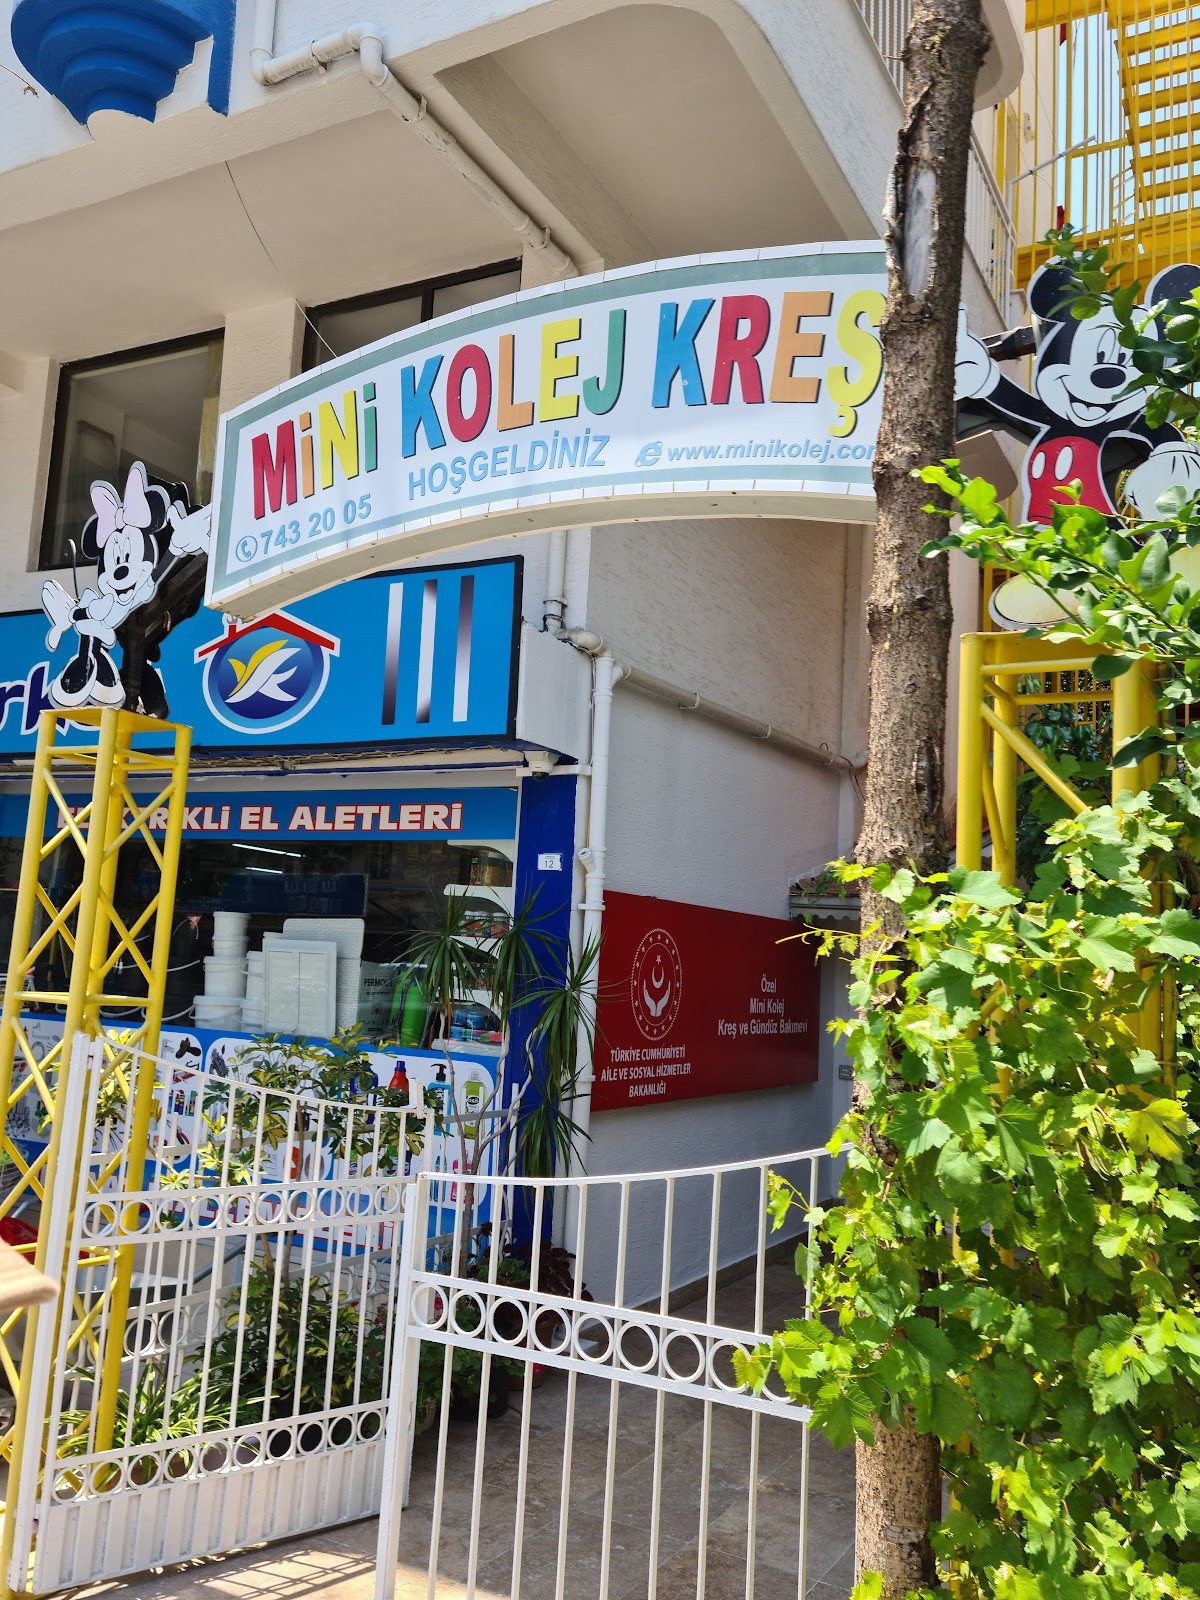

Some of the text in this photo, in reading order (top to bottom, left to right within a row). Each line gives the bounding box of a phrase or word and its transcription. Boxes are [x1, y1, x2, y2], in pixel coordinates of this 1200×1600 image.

[400, 308, 627, 459] KOLEJ
[651, 289, 887, 438] KREŞ
[408, 427, 610, 500] HOŞGELDİNİZ
[260, 493, 372, 555] 743 20 05
[240, 805, 279, 831] EL
[545, 859, 554, 869] 12
[760, 973, 777, 993] Özel
[749, 997, 785, 1017] Mini Kolej
[718, 1018, 808, 1039] Kreş ve Gündüz Bakımevi
[610, 1043, 686, 1063] TÜRKİYE CUMHURİYETİ
[600, 1062, 692, 1082] AİLE VE SOSYAL HİZMETLER
[628, 1080, 667, 1098] BAKANLIĞI
